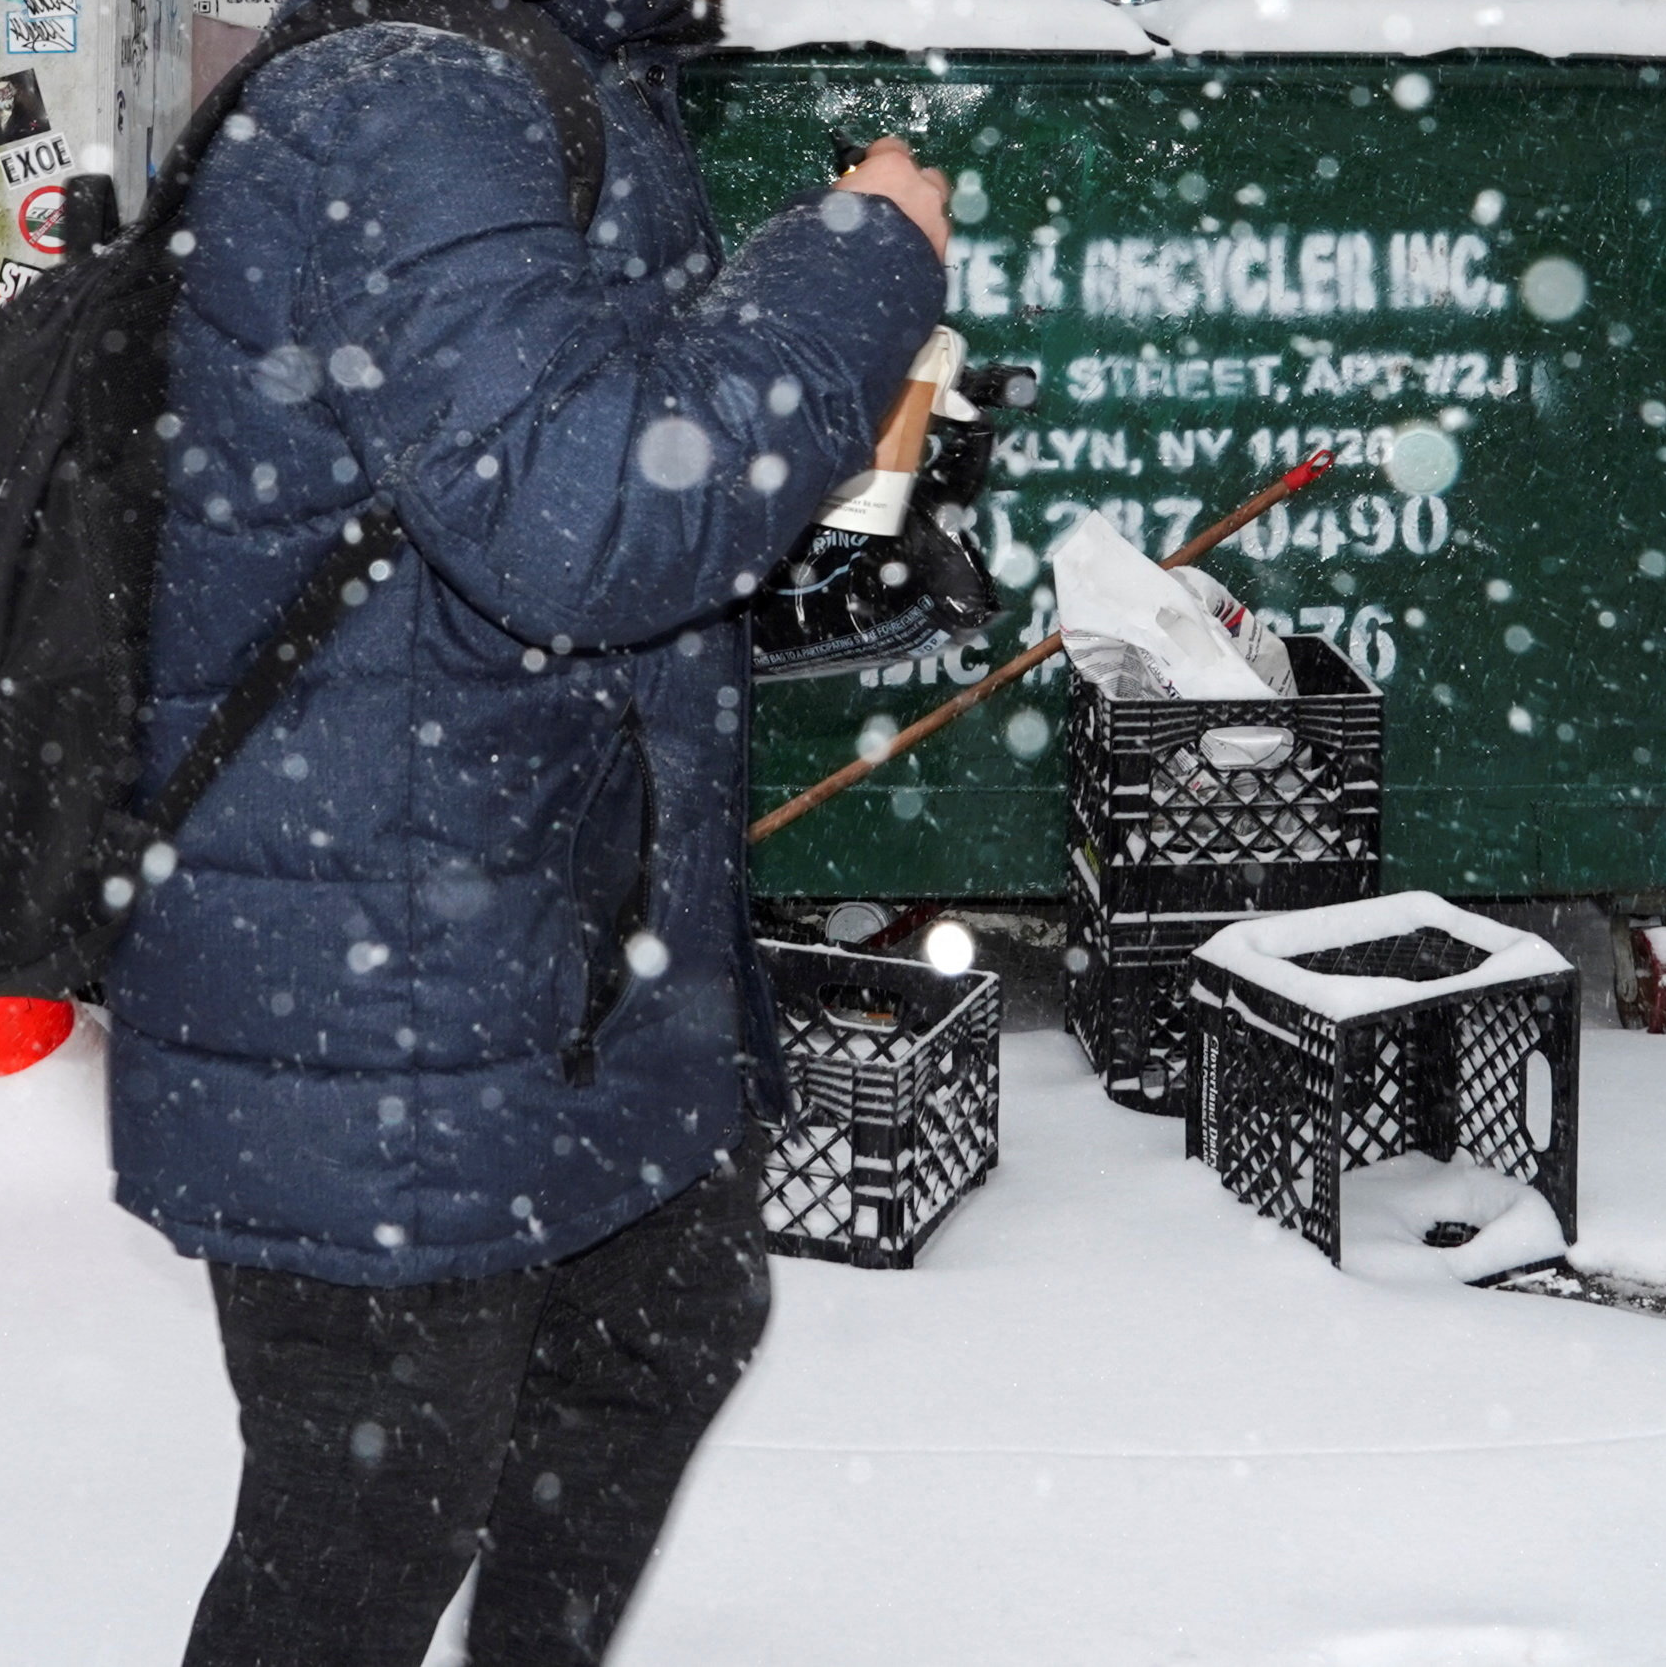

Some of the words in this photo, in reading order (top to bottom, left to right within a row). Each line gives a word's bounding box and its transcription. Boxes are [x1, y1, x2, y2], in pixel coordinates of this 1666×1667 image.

[1, 138, 72, 185] EXOE
[1081, 234, 1375, 316] RECYCLER
[1387, 232, 1509, 311] INC.
[1066, 354, 1290, 404] STREET,
[990, 429, 1144, 475] KLYN,
[1158, 429, 1233, 467] NY
